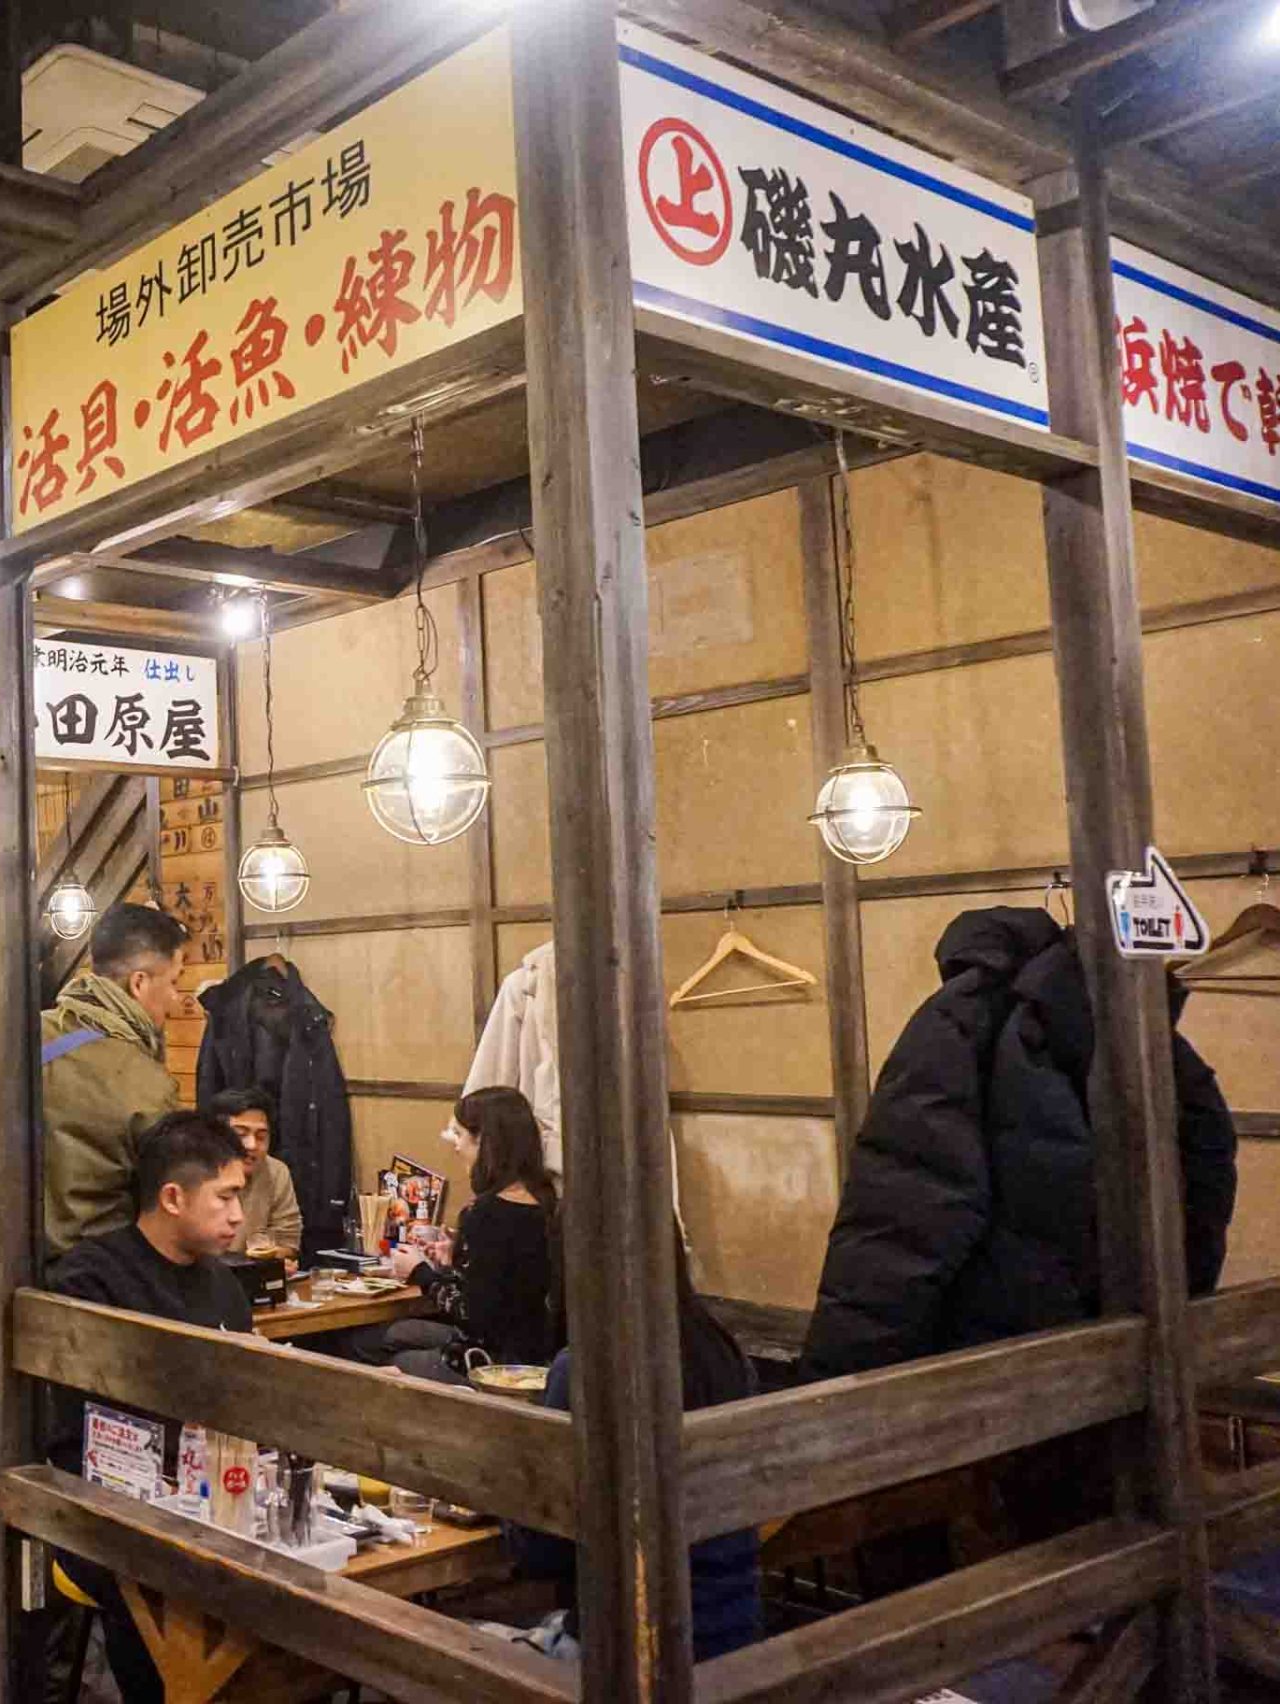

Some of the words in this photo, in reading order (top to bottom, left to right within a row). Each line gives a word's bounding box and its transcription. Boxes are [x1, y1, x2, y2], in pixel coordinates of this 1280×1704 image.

[95, 140, 372, 346] 場外卸売市場
[737, 165, 1026, 369] 磯丸水産
[144, 658, 197, 682] 仕出し
[34, 693, 210, 761] 田原屋
[1132, 917, 1171, 938] TOILET
